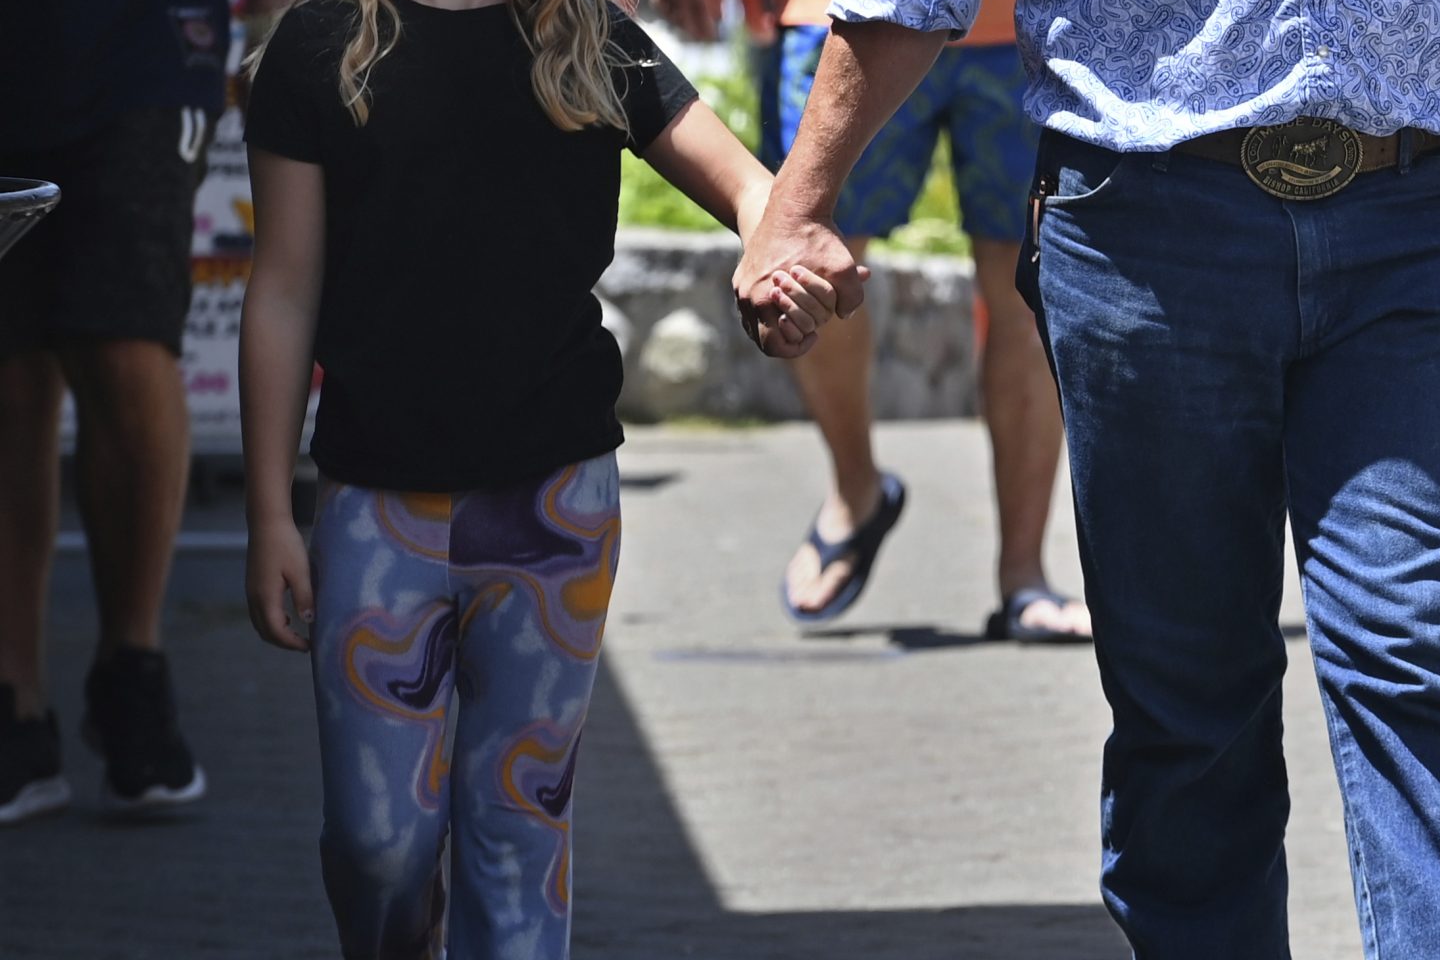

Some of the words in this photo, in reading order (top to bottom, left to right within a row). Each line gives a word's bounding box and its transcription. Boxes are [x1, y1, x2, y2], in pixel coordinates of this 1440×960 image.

[1311, 117, 1350, 142] DAYS
[1263, 176, 1291, 193] BISHOP
[1294, 179, 1340, 195] CALIFORNIA
